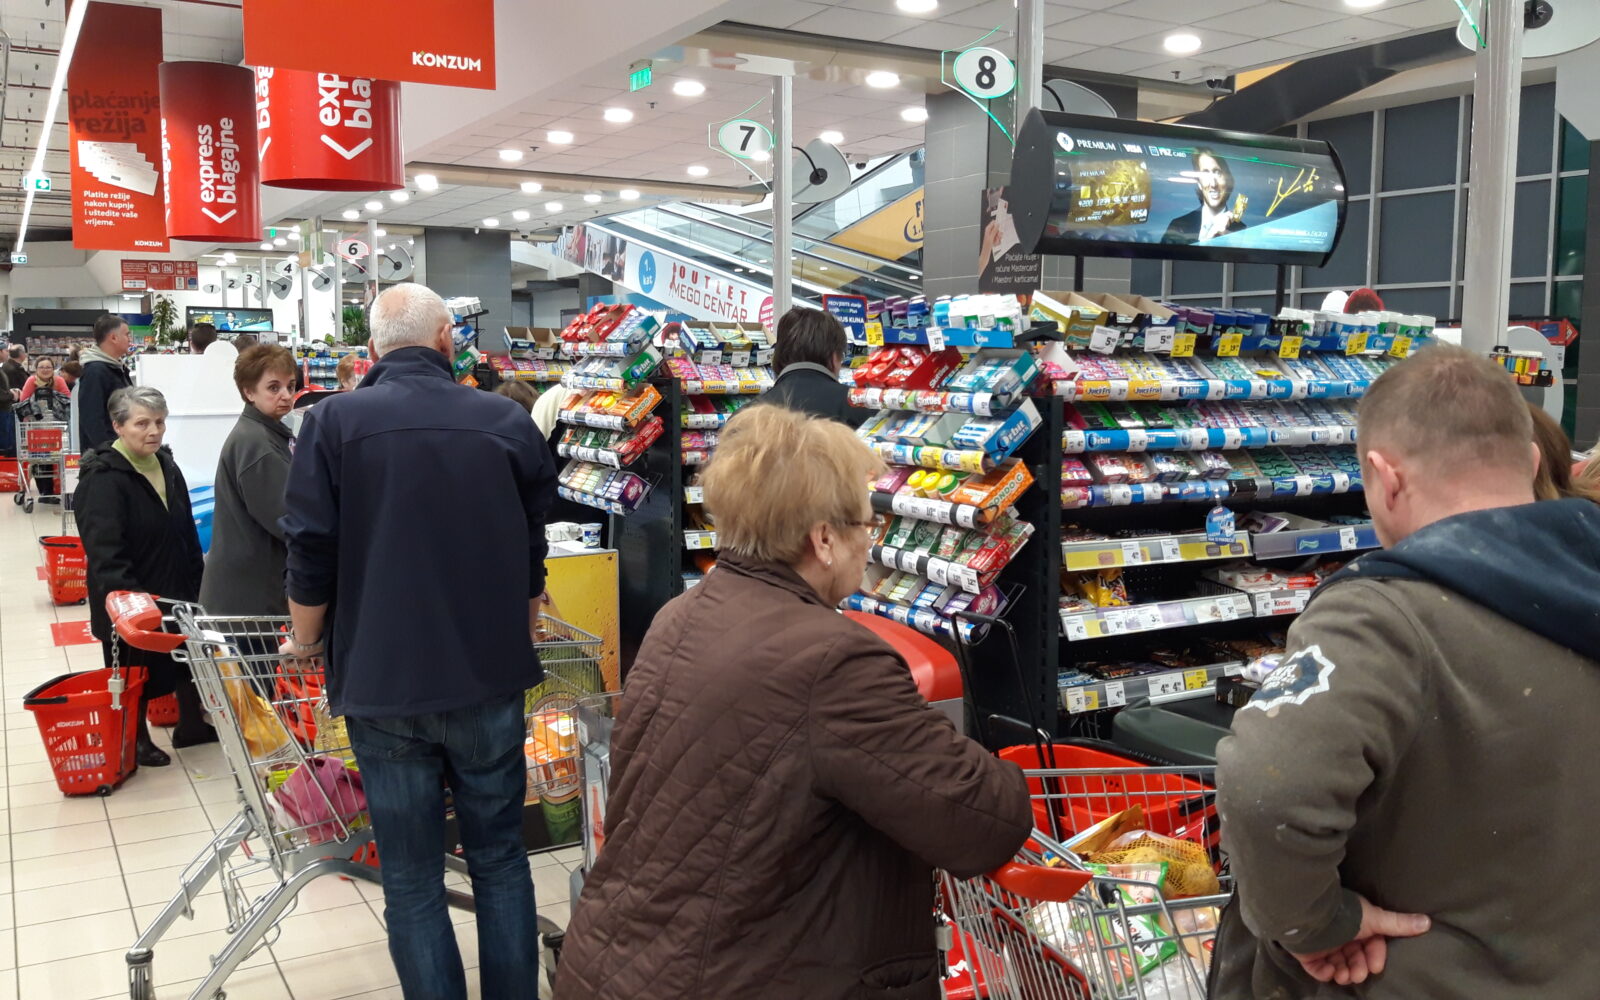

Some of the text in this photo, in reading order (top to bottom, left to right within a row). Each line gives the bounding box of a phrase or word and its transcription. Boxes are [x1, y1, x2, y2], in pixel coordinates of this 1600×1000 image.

[412, 50, 481, 72] KONZUM
[975, 56, 997, 90] 8
[71, 89, 160, 115] plaćanje
[73, 110, 147, 140] režija
[739, 125, 756, 152] 7
[1077, 139, 1117, 151] PREMIUM
[197, 124, 215, 203] express
[214, 117, 241, 204] blagajne
[83, 190, 131, 201] Platite režije
[109, 201, 135, 210] kupnje
[89, 209, 120, 218] uštedite
[1130, 208, 1148, 219] VISA
[84, 218, 115, 227] vrijeme.
[348, 242, 358, 256] 6
[283, 263, 292, 274] 4
[228, 279, 236, 289] 2
[245, 274, 252, 284] 3
[642, 275, 653, 286] kat
[209, 285, 215, 293] 1
[679, 265, 748, 305] OUTLET
[703, 293, 748, 323] CENTAR
[848, 316, 865, 324] KUNA
